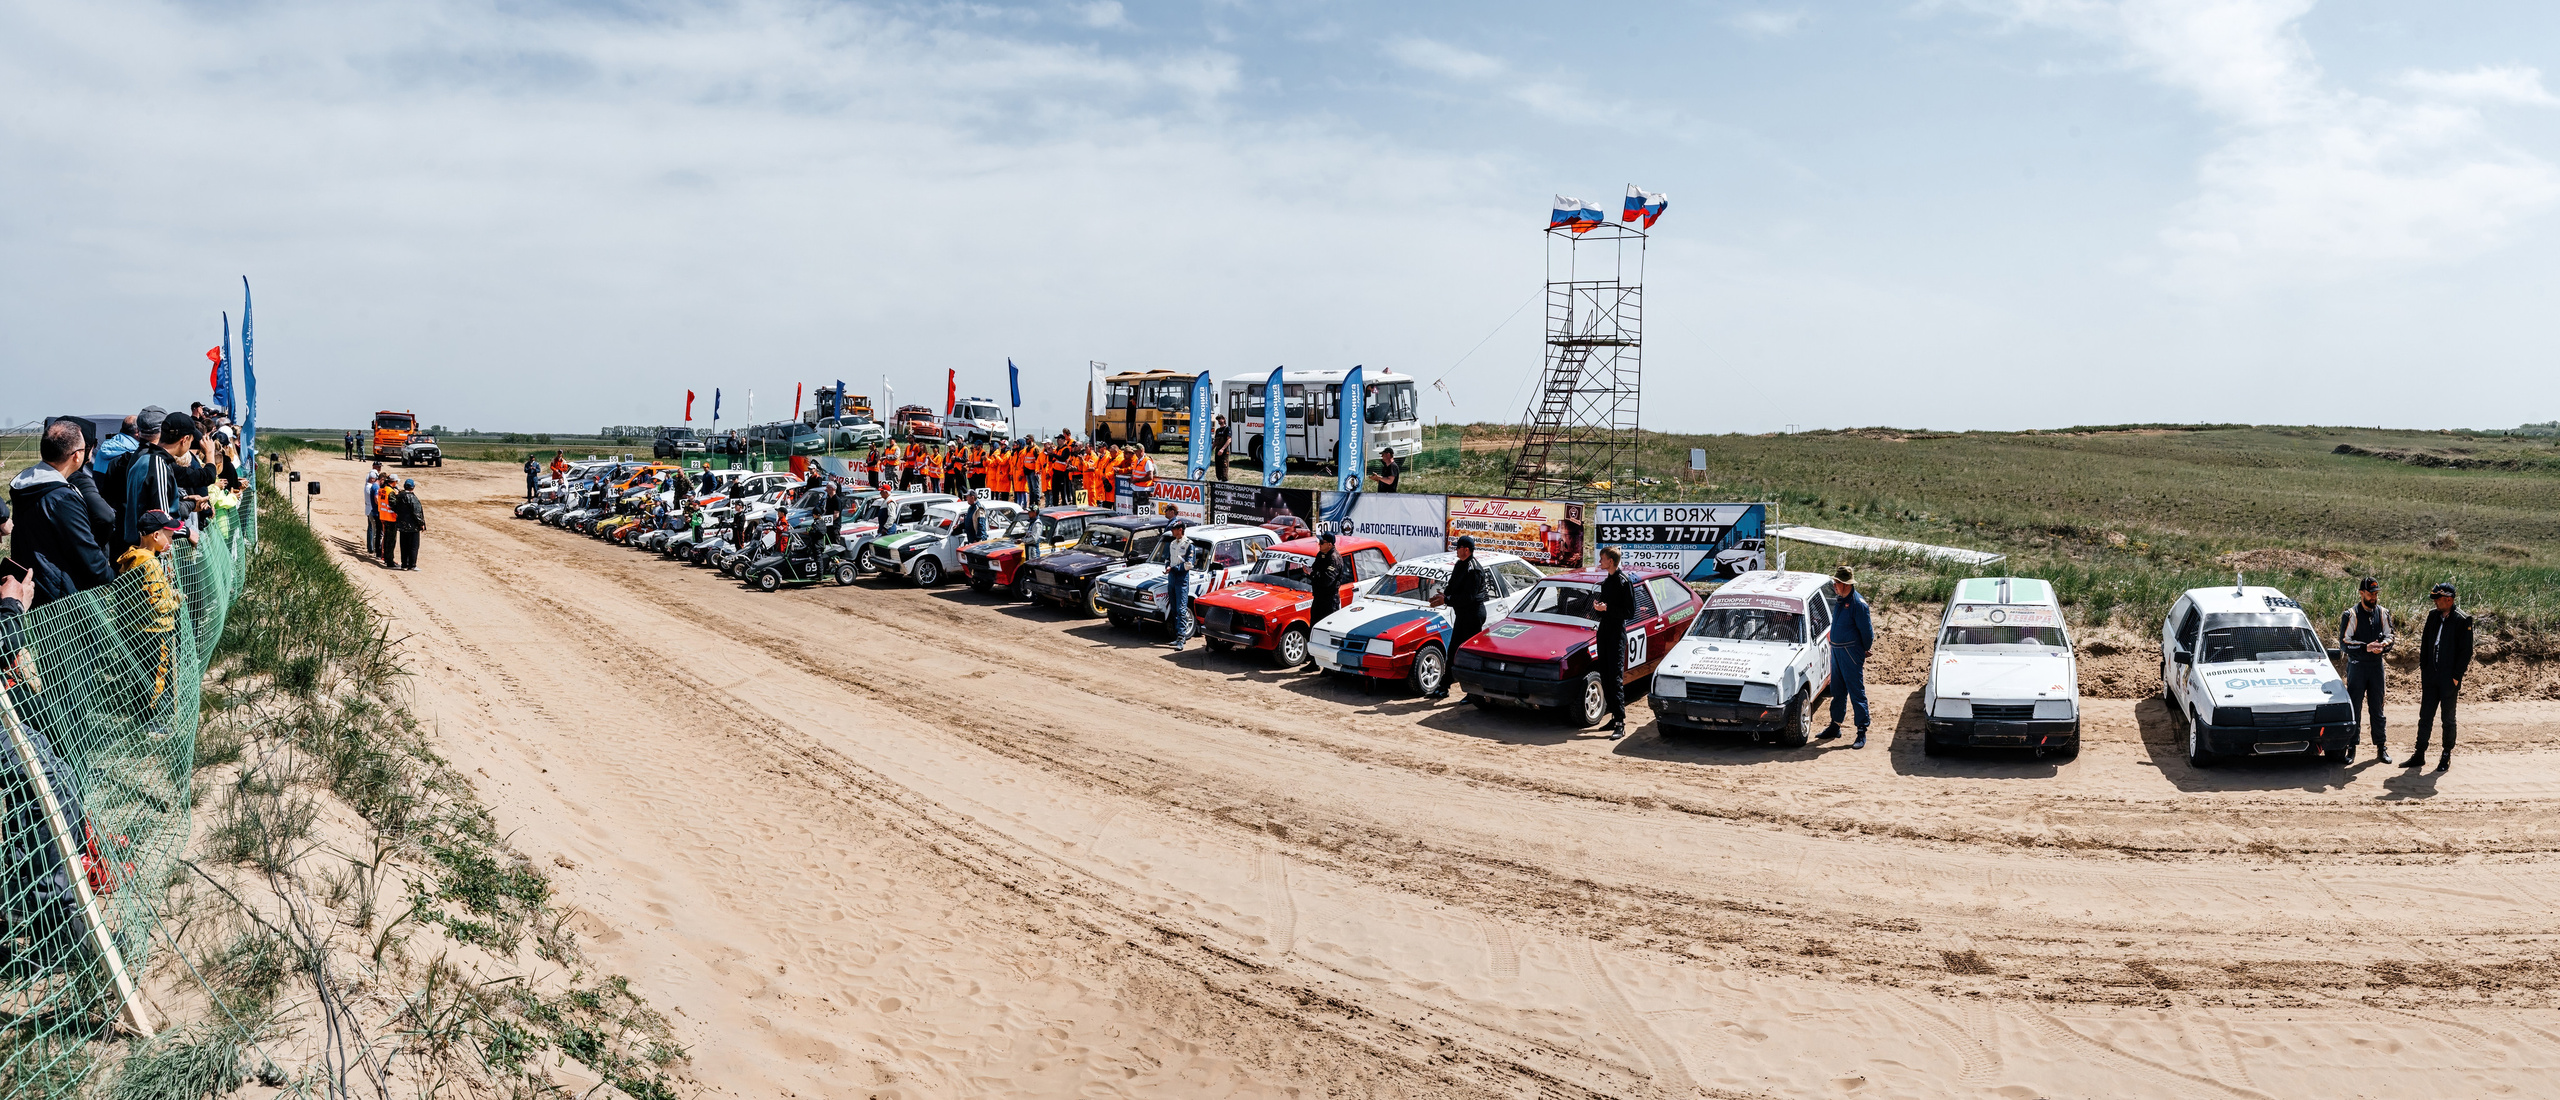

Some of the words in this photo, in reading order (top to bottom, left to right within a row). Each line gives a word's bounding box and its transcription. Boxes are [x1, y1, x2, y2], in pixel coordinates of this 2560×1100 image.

[1196, 386, 1206, 466] АвтоСпецТехника
[1272, 384, 1281, 468] АвтоСпецТехника
[1349, 383, 1358, 472] АвтоСпецТехника
[732, 463, 742, 471] 93
[763, 462, 773, 472] 20
[844, 477, 855, 485] 84
[911, 485, 922, 493] 25
[977, 489, 990, 499] 53
[1150, 484, 1201, 502] АМАРА
[1076, 491, 1087, 504] 47
[1138, 506, 1150, 515] 39
[1602, 508, 1657, 522] ТАКСИ
[1663, 508, 1717, 522] ВОЯЖ
[1215, 514, 1226, 525] 69
[1456, 520, 1488, 531] БОЧКОВОЕ
[1493, 522, 1518, 533] ЖИВОЕ
[1602, 526, 1655, 541] 33-333
[1665, 527, 1720, 542] 77-777
[805, 562, 818, 572] 69
[1237, 589, 1265, 598] 30
[1651, 579, 1667, 601] 97
[2007, 613, 2052, 624] ГЕПАРД
[1629, 633, 1646, 663] 97
